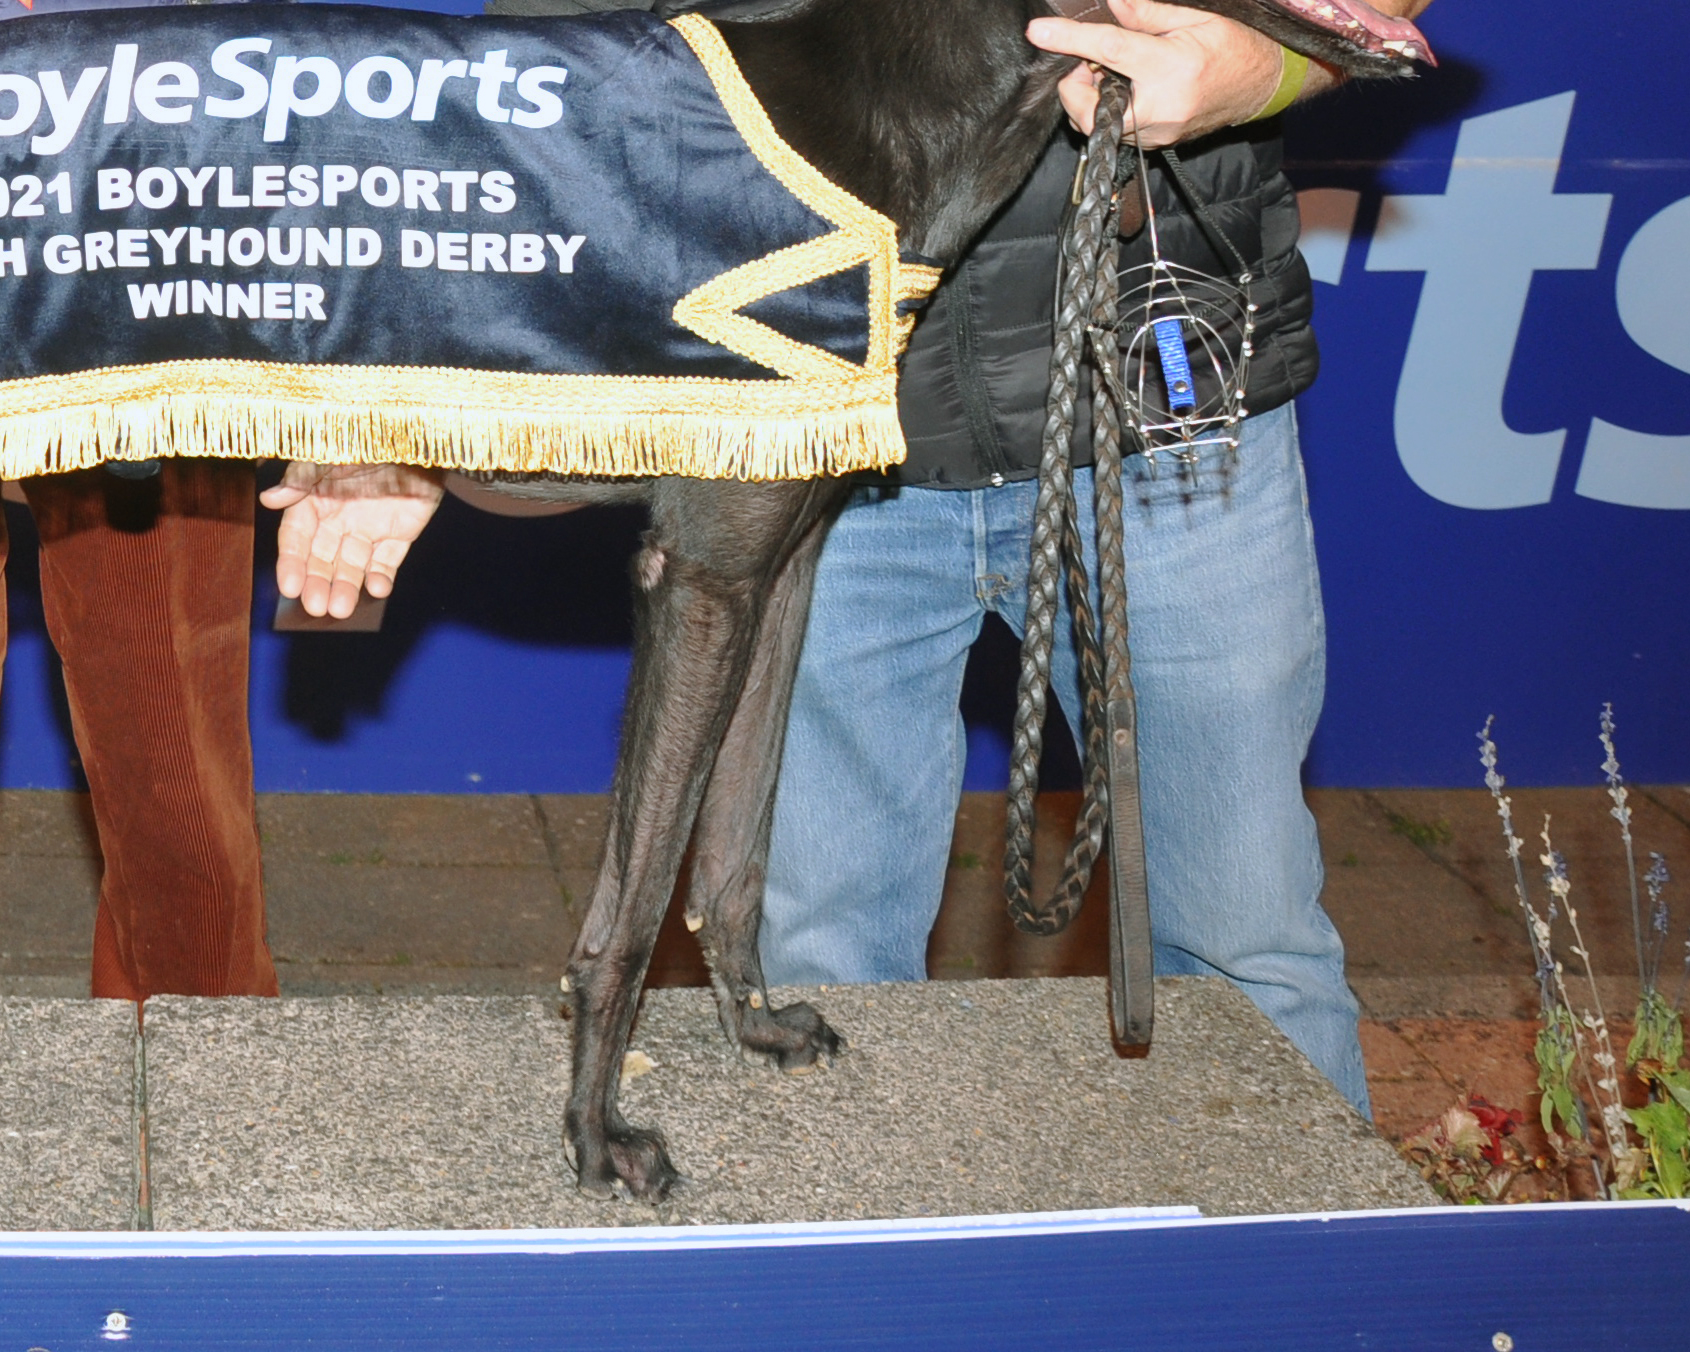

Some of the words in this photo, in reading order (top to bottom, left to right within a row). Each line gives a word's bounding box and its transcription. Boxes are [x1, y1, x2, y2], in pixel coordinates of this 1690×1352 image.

[97, 164, 517, 215] BOYLESPORTS
[42, 226, 382, 276] GREYHOUND
[400, 230, 587, 275] DERBY
[127, 282, 327, 322] WINNER
